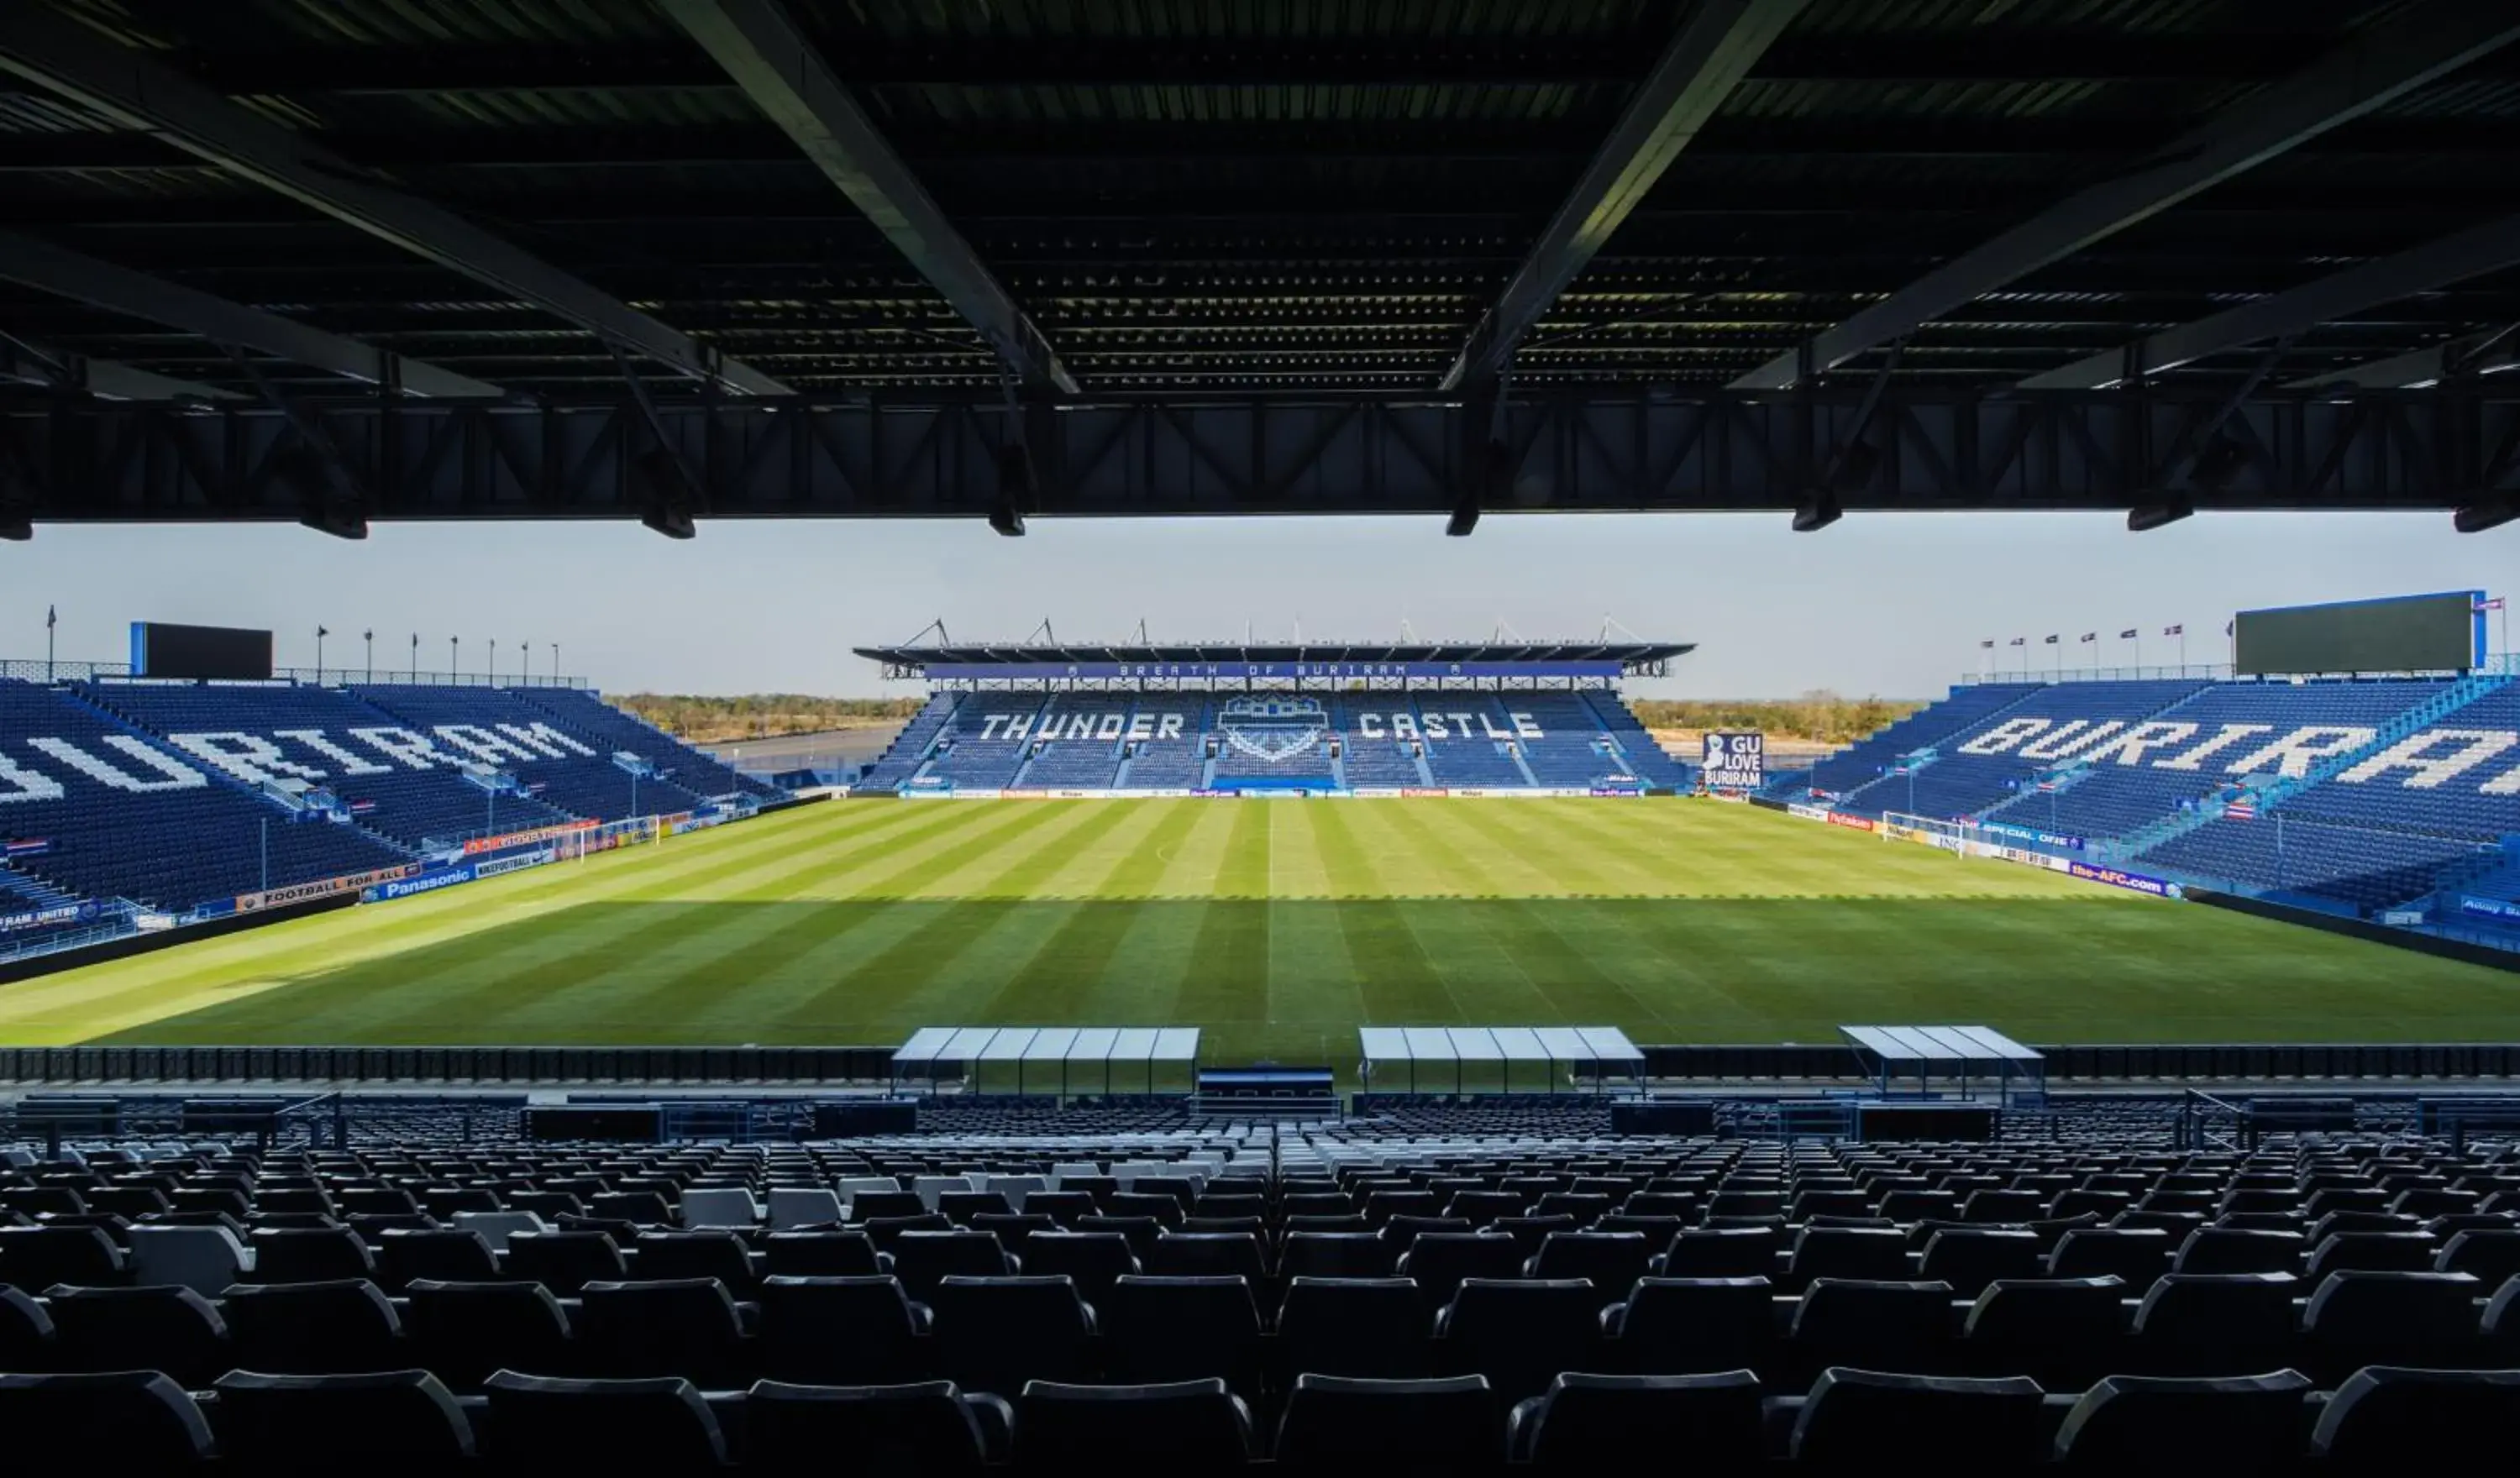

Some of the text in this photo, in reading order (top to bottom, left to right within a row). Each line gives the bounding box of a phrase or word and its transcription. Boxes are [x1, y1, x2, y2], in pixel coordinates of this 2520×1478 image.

[1120, 665, 1406, 675] BREATH OF BURIRAM
[979, 713, 1184, 740] THUNDER
[1360, 712, 1544, 739] CASTLE
[1731, 736, 1761, 753] GU
[1956, 717, 2520, 795] BURIRA
[1725, 753, 1761, 771] LOVE
[1704, 770, 1761, 789] BURIRAM
[265, 879, 338, 903] FOOTBALL
[347, 874, 373, 887] FOR
[380, 868, 401, 881] ALL
[387, 870, 470, 898] Panasonic
[2071, 864, 2162, 893] the-AFC.com
